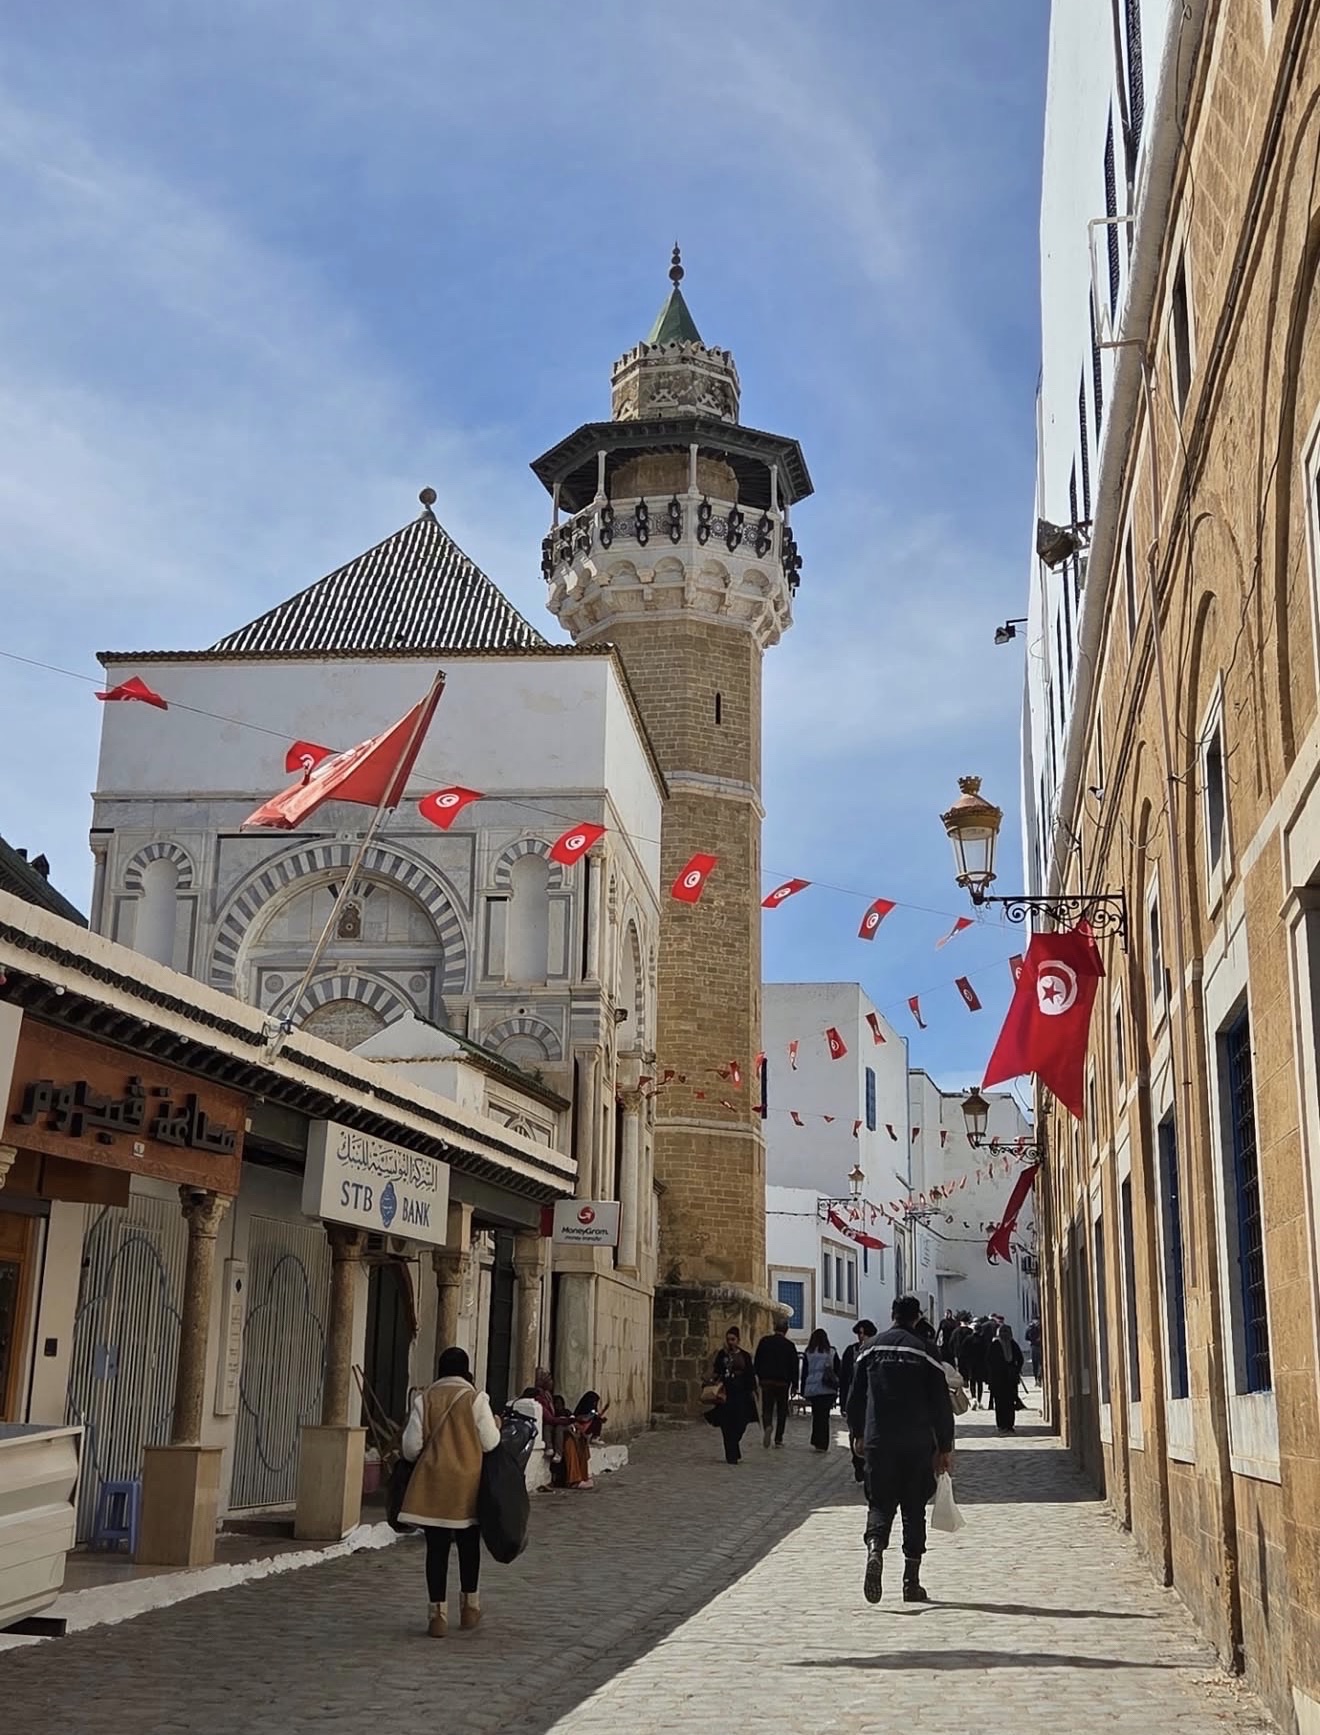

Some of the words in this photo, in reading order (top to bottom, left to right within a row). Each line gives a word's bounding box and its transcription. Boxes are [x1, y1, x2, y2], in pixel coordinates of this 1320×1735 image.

[337, 1131, 369, 1170] للبنك
[368, 1142, 413, 1184] التونسية
[411, 1156, 438, 1193] الشركة
[341, 1180, 373, 1212] STB
[402, 1197, 431, 1228] BANK
